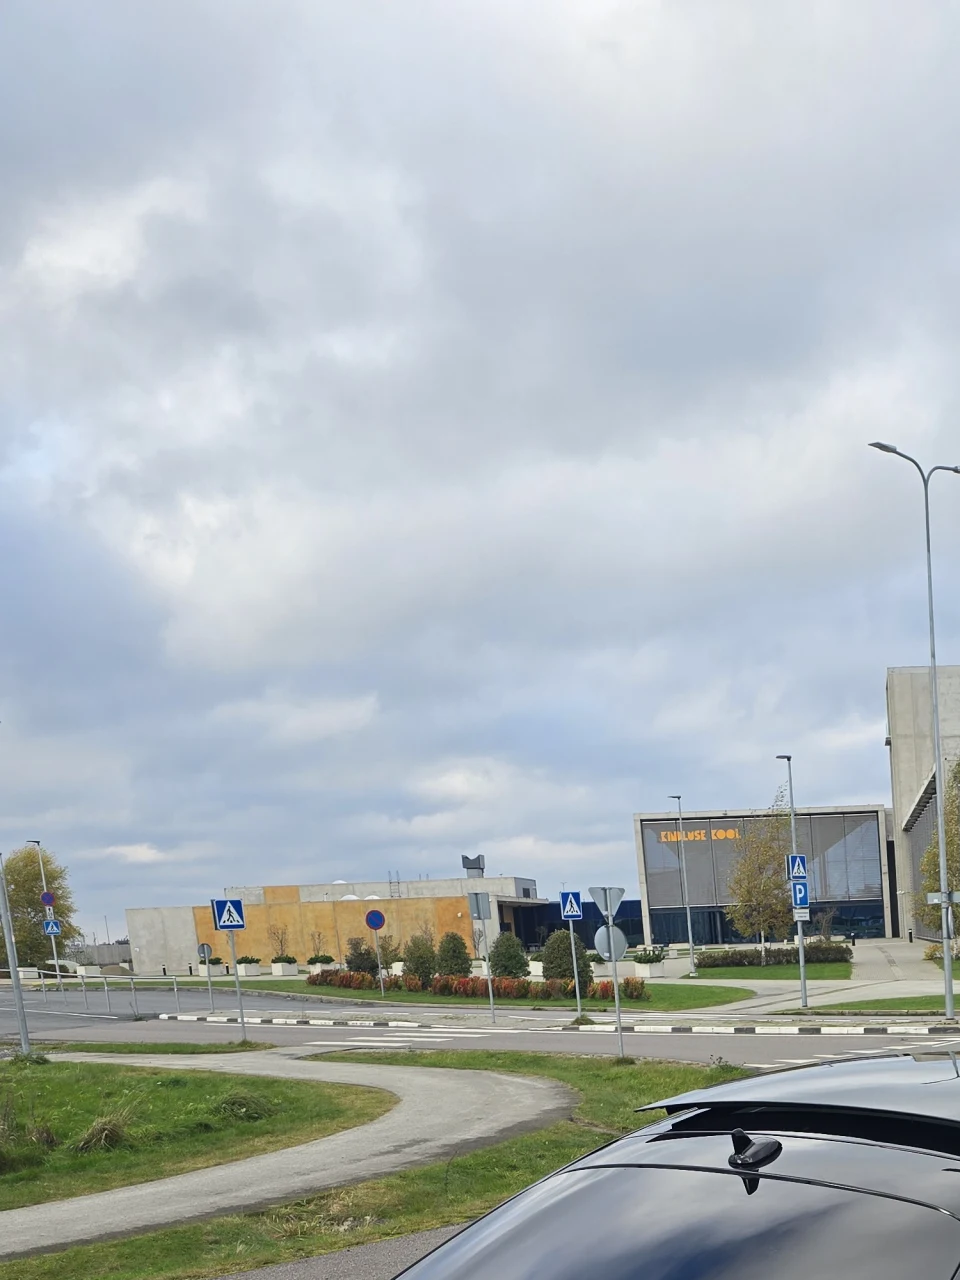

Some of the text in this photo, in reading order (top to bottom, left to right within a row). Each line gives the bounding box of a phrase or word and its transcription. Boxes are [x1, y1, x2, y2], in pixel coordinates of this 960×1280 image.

[660, 828, 741, 842] KINDLUSE KOOL
[795, 884, 804, 904] P
